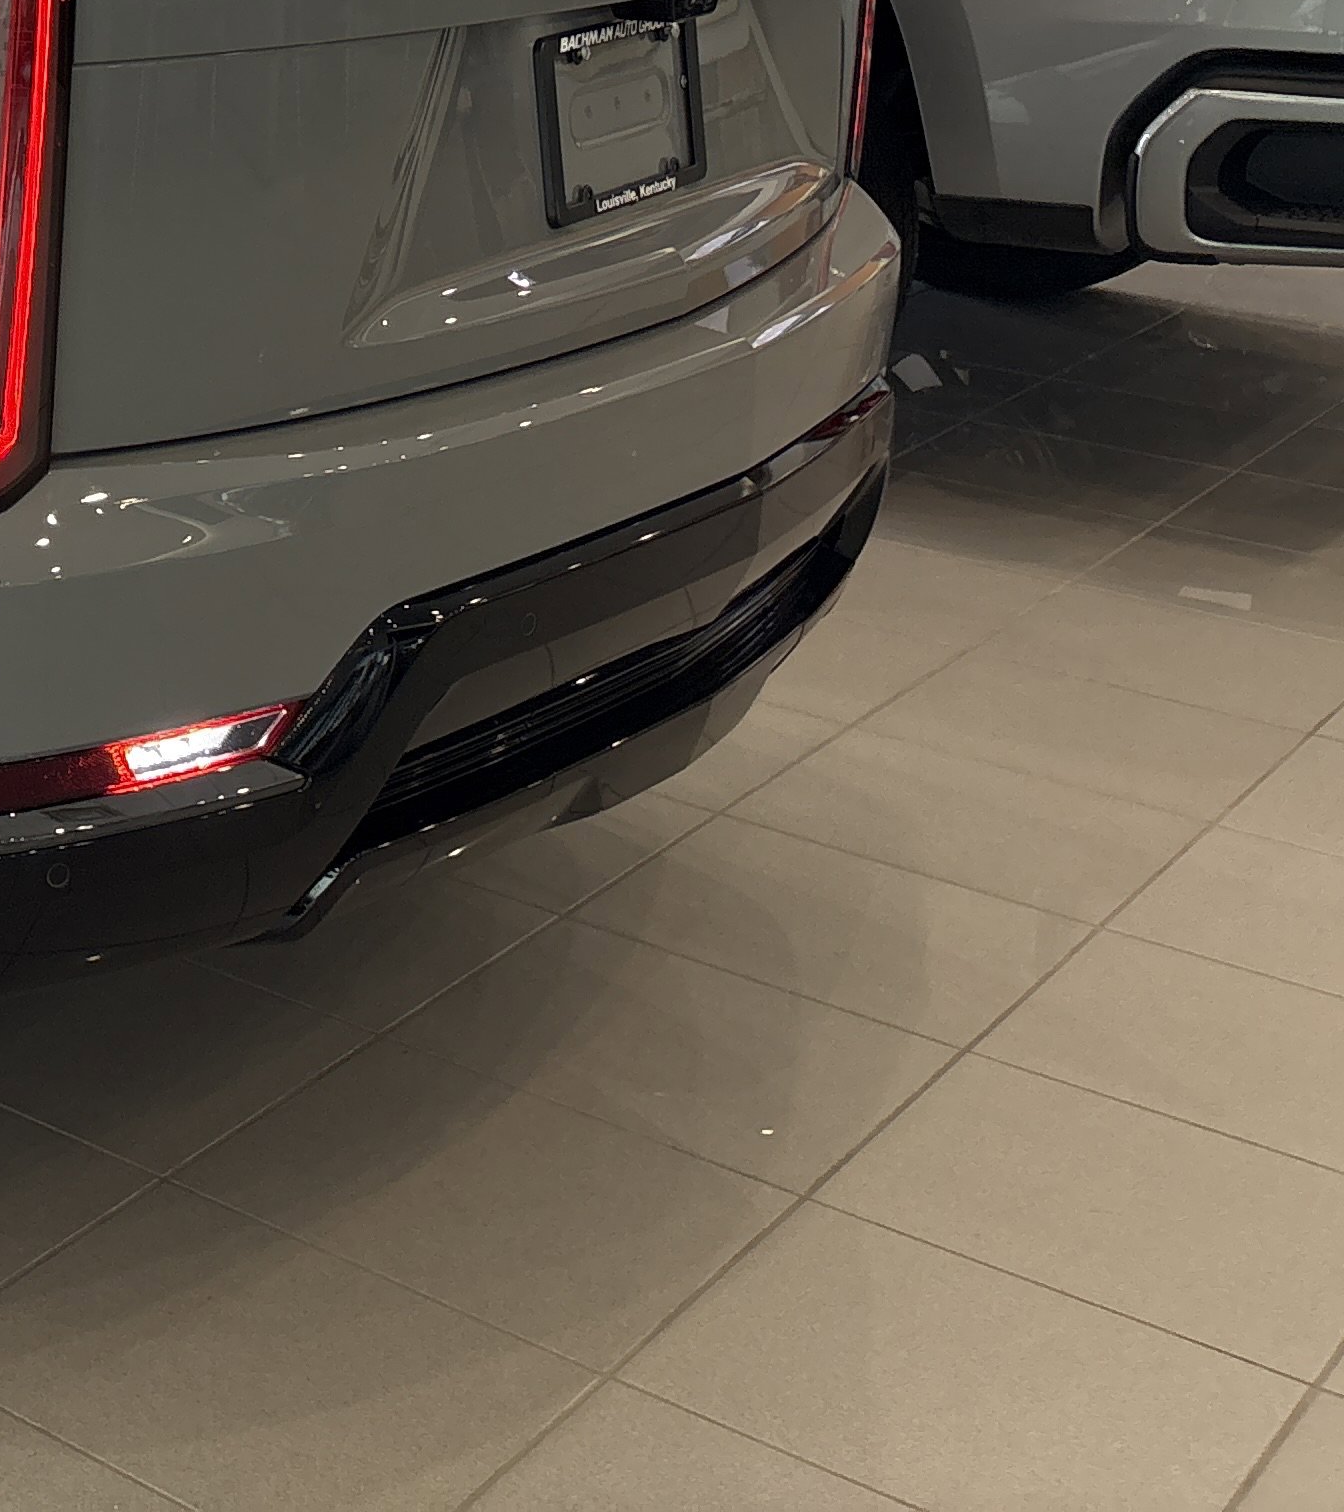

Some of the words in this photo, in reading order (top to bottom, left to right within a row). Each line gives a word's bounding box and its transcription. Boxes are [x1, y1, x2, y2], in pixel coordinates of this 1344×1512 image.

[559, 25, 615, 53] BACHMAN
[614, 19, 638, 39] AUTO
[595, 189, 639, 213] Louisville,
[639, 176, 677, 199] Kentucky
